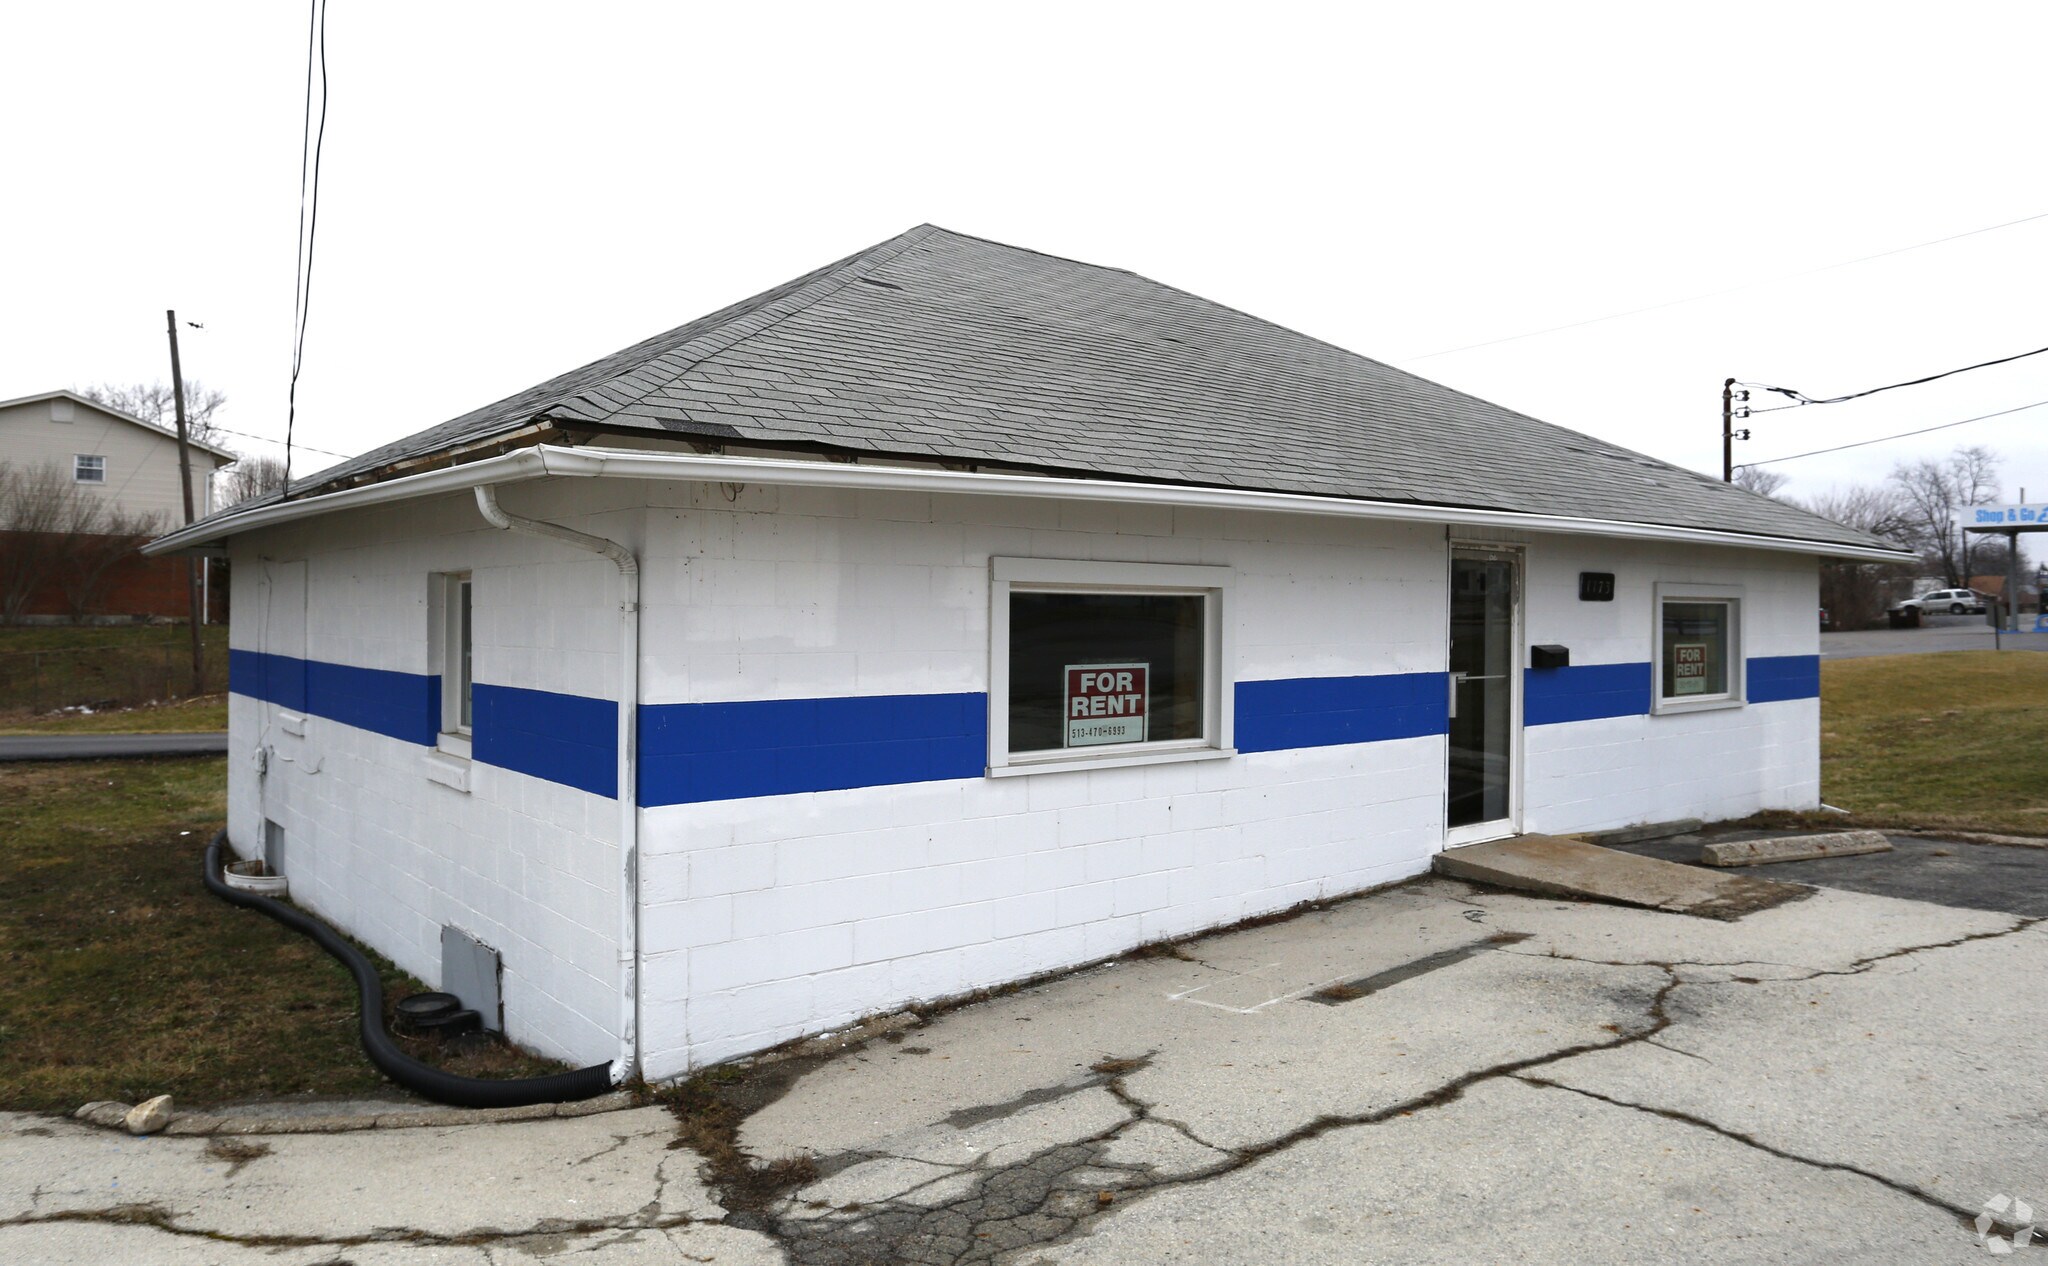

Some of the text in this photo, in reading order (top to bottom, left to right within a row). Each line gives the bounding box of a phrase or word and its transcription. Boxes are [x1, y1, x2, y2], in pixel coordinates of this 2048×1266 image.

[1976, 509, 2004, 523] Shop
[2008, 508, 2017, 521] &
[2020, 507, 2036, 521] Go
[1680, 649, 1701, 662] FOR
[1677, 663, 1704, 676] RENT
[1080, 672, 1133, 693] FOR
[1071, 694, 1142, 717] RENT
